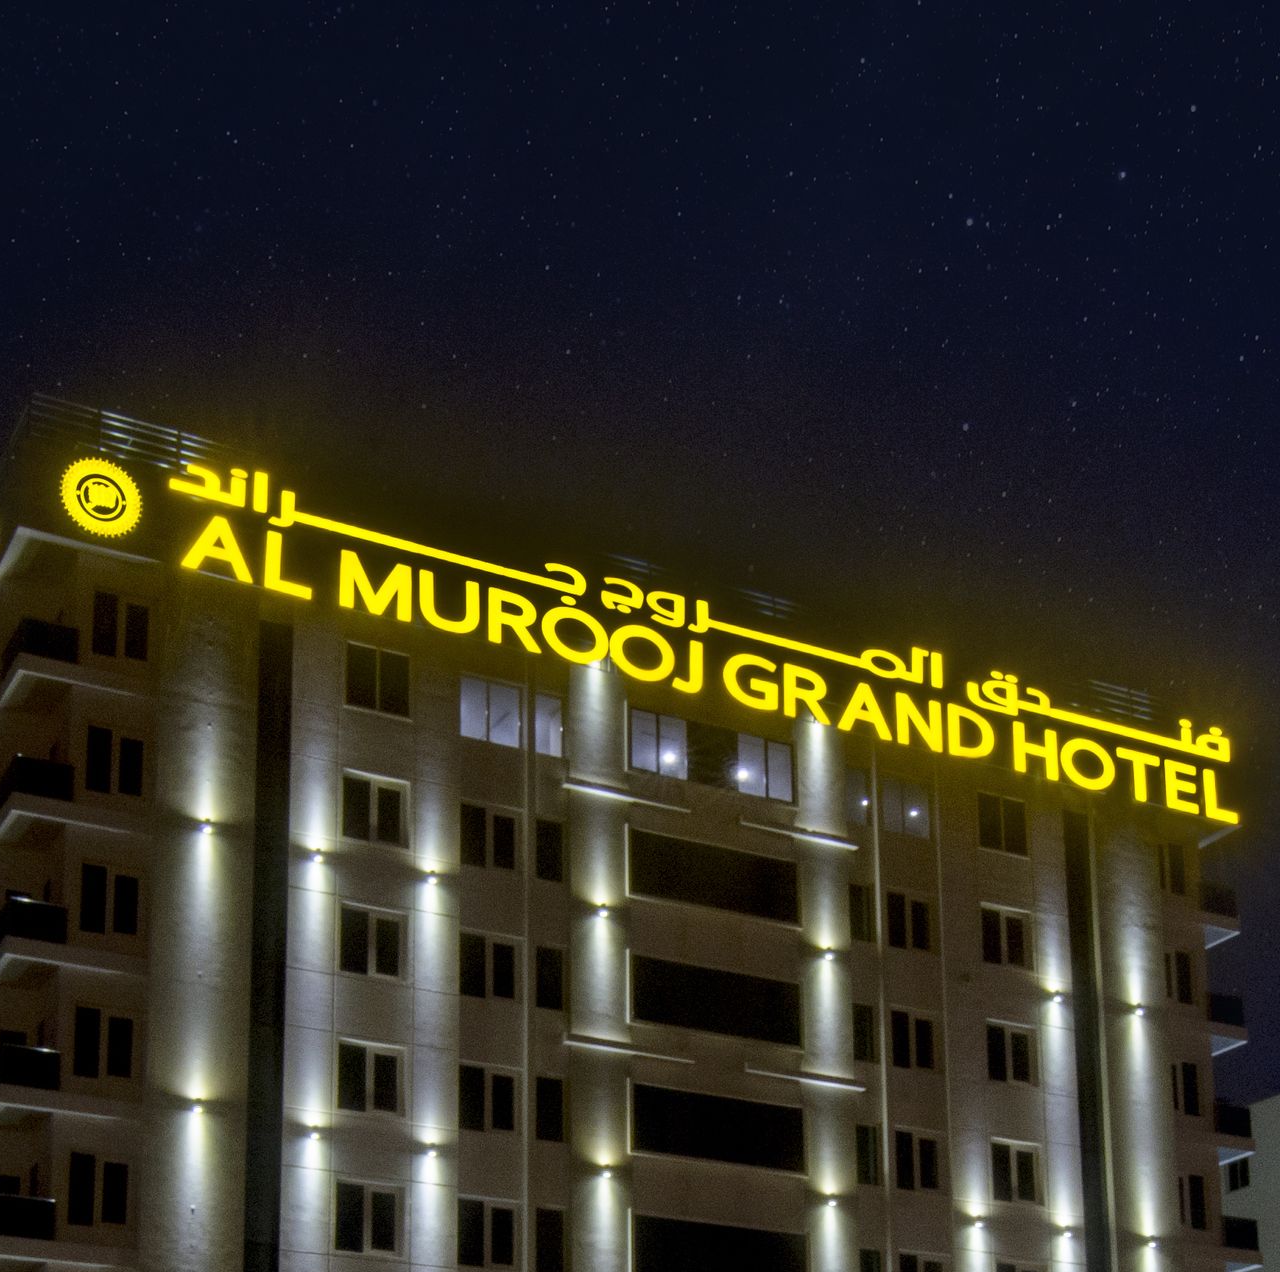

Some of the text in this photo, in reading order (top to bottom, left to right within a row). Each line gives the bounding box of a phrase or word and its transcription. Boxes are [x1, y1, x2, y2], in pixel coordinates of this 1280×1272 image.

[168, 462, 1232, 764] فندق المروج جراند
[179, 514, 1240, 826] AL MUROOJ GRAND HOTEL
